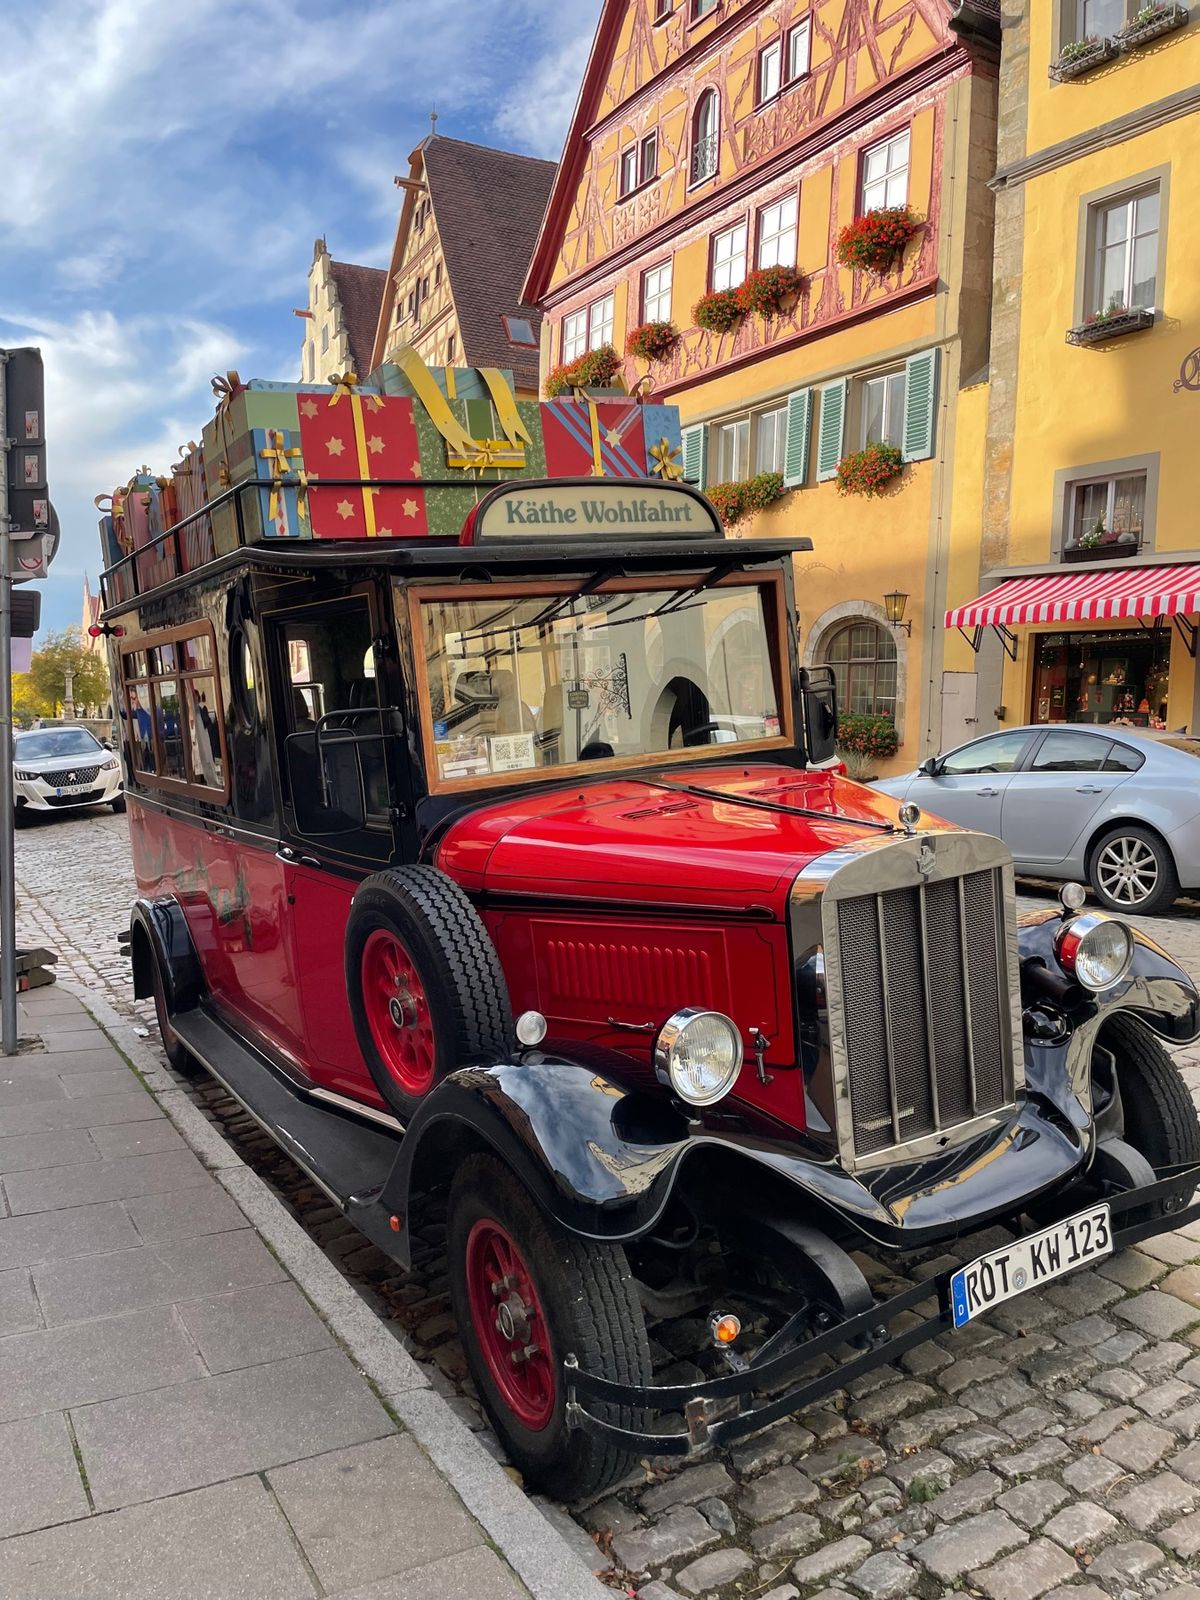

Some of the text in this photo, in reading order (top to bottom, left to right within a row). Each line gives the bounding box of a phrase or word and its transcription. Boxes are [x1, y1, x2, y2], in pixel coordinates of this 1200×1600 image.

[505, 499, 692, 523] Käthe Wohlfahrt
[966, 1212, 1108, 1312] ROT KW 123
[958, 1305, 964, 1316] D
